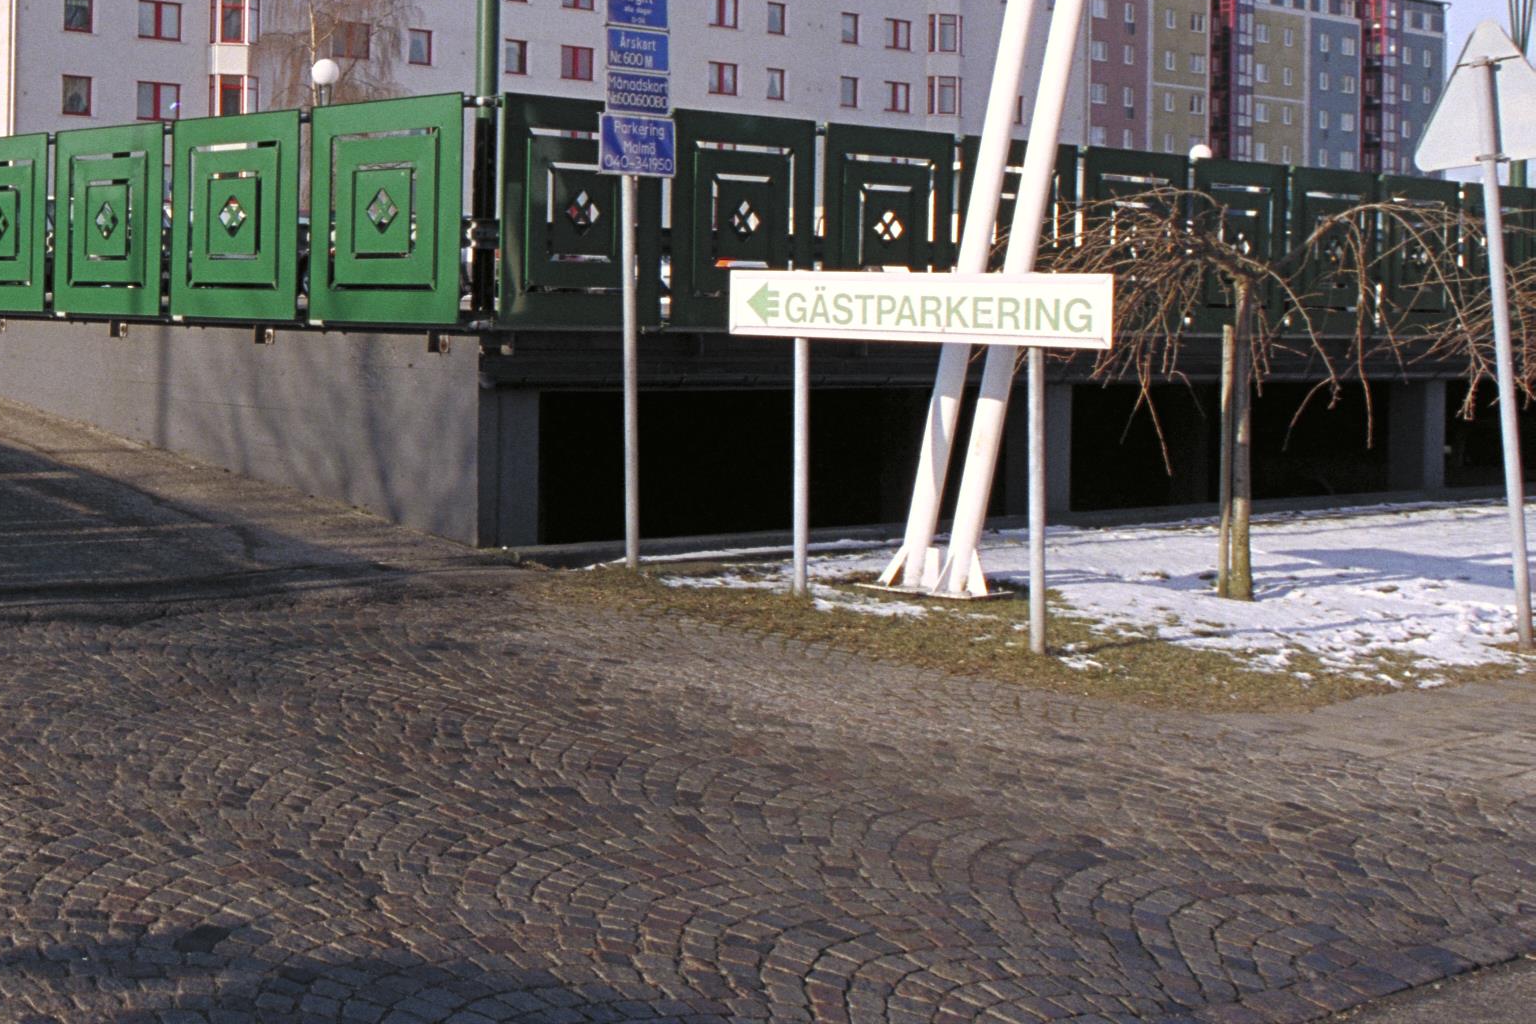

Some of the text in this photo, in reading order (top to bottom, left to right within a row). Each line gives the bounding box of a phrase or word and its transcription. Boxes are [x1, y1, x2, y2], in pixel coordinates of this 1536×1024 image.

[619, 31, 657, 52] Årskort
[623, 51, 644, 66] 600
[614, 120, 665, 140] Parkering
[623, 141, 656, 155] Malmö
[604, 154, 673, 171] 040-341950
[784, 285, 1094, 334] GÄSTPARKERING
